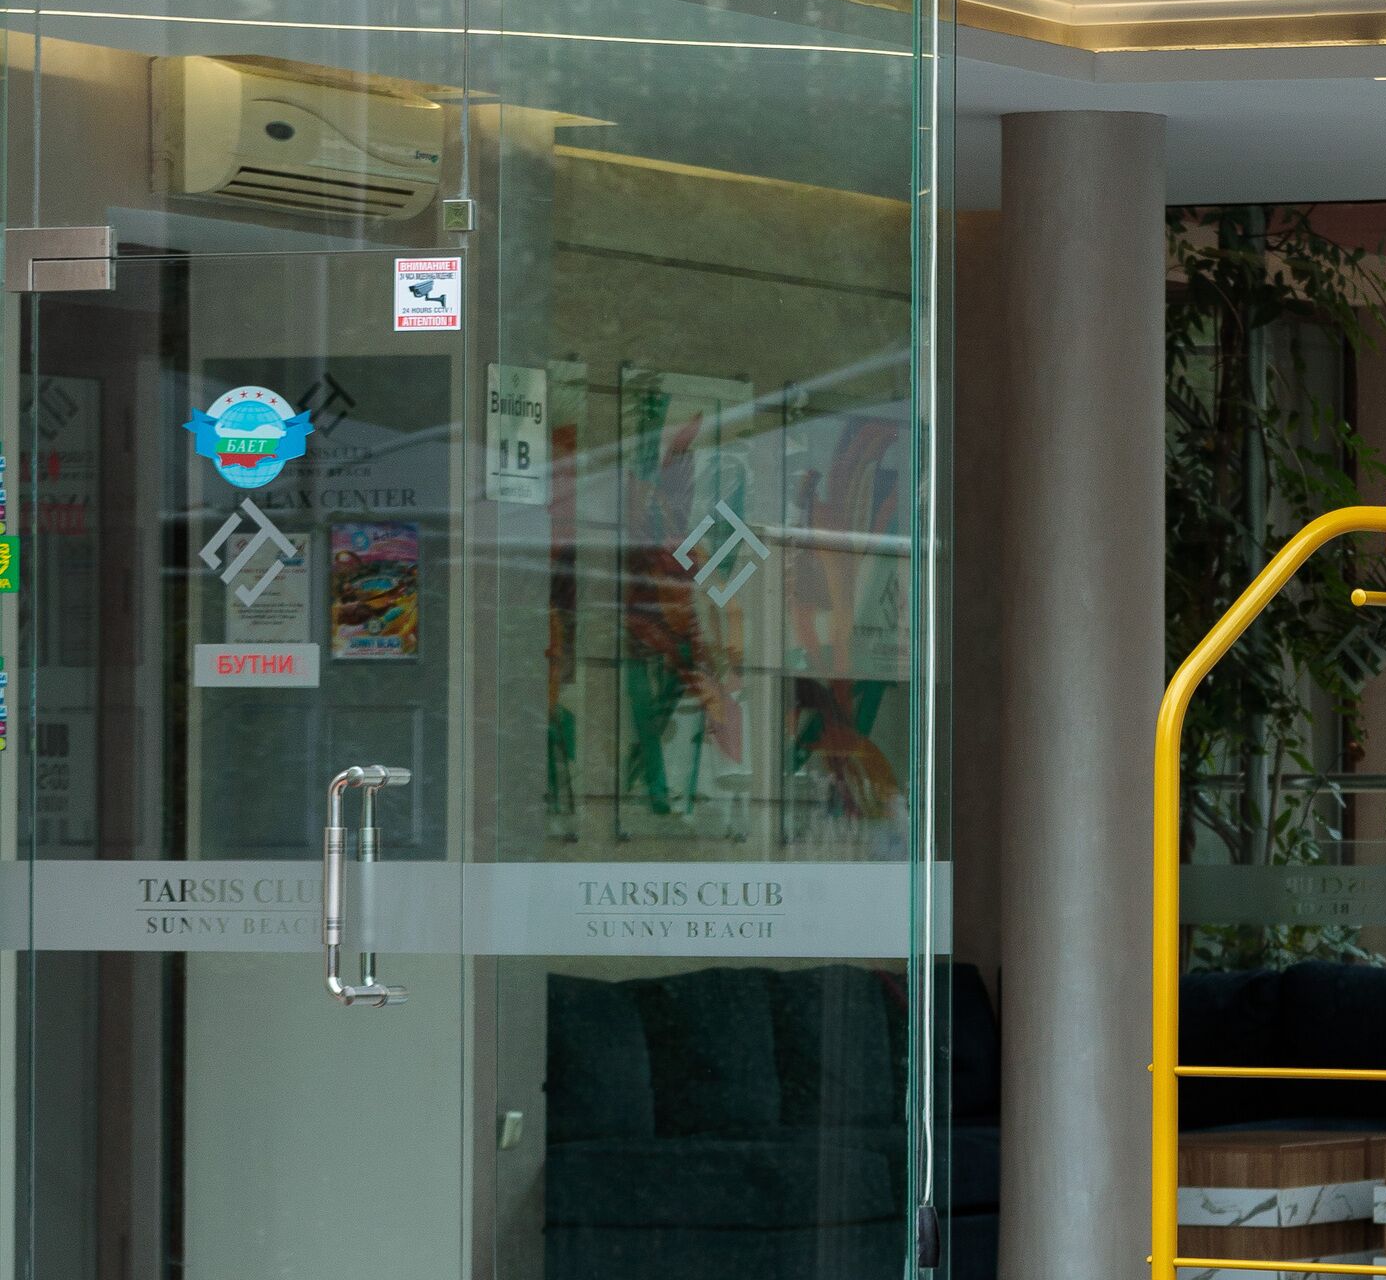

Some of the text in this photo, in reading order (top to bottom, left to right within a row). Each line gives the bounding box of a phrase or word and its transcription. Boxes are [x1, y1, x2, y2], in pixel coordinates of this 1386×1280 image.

[226, 439, 267, 453] БАЕТ
[320, 488, 416, 508] CENTER
[217, 654, 294, 674] БУТНИ
[138, 878, 323, 904] TARSIS CLU
[578, 881, 784, 907] TARSIS CLUB
[146, 916, 232, 934] SUNNY
[586, 921, 773, 939] SUNNY BEACH
